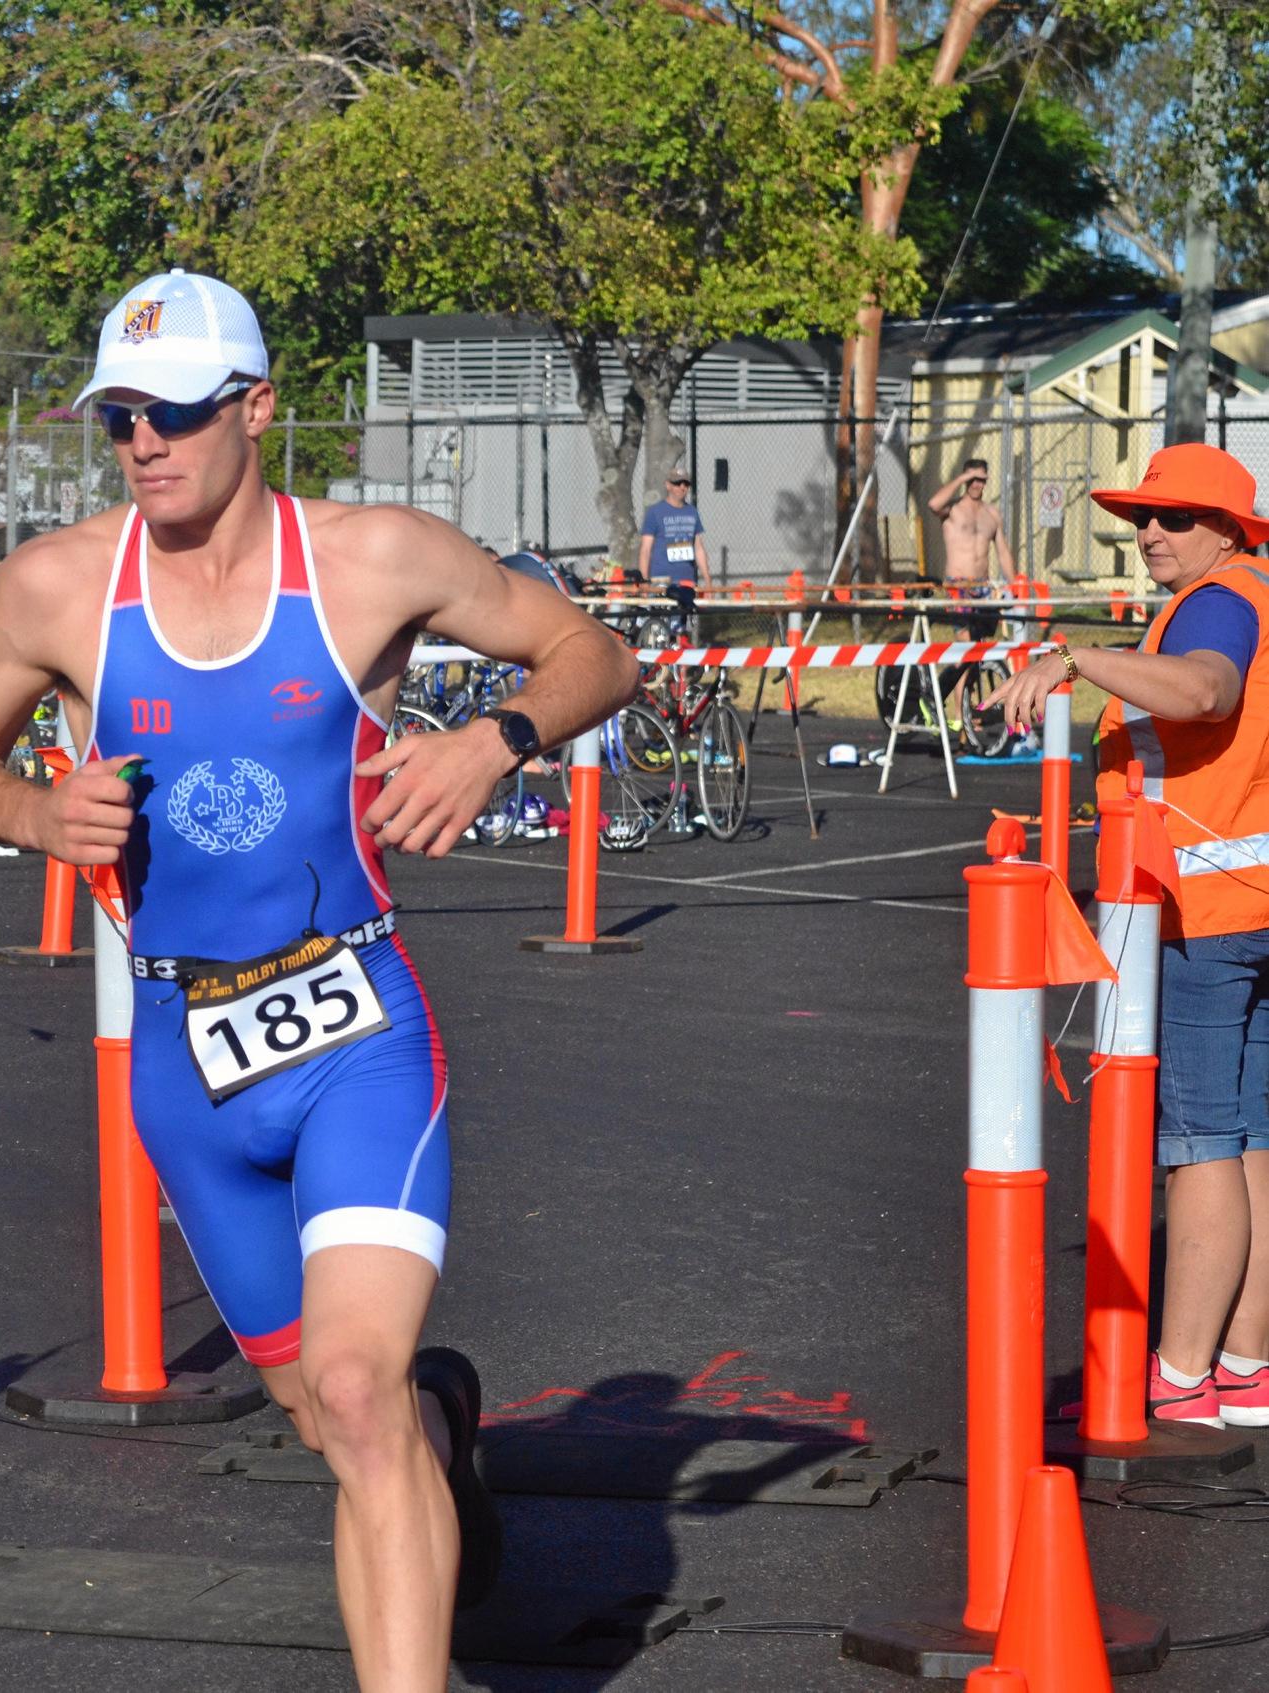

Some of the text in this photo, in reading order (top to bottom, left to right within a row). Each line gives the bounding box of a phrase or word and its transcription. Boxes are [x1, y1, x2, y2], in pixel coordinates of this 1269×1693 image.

[131, 698, 171, 734] DD
[209, 985, 233, 998] SPORTS
[236, 961, 277, 990] DALBY
[206, 969, 359, 1071] 185
